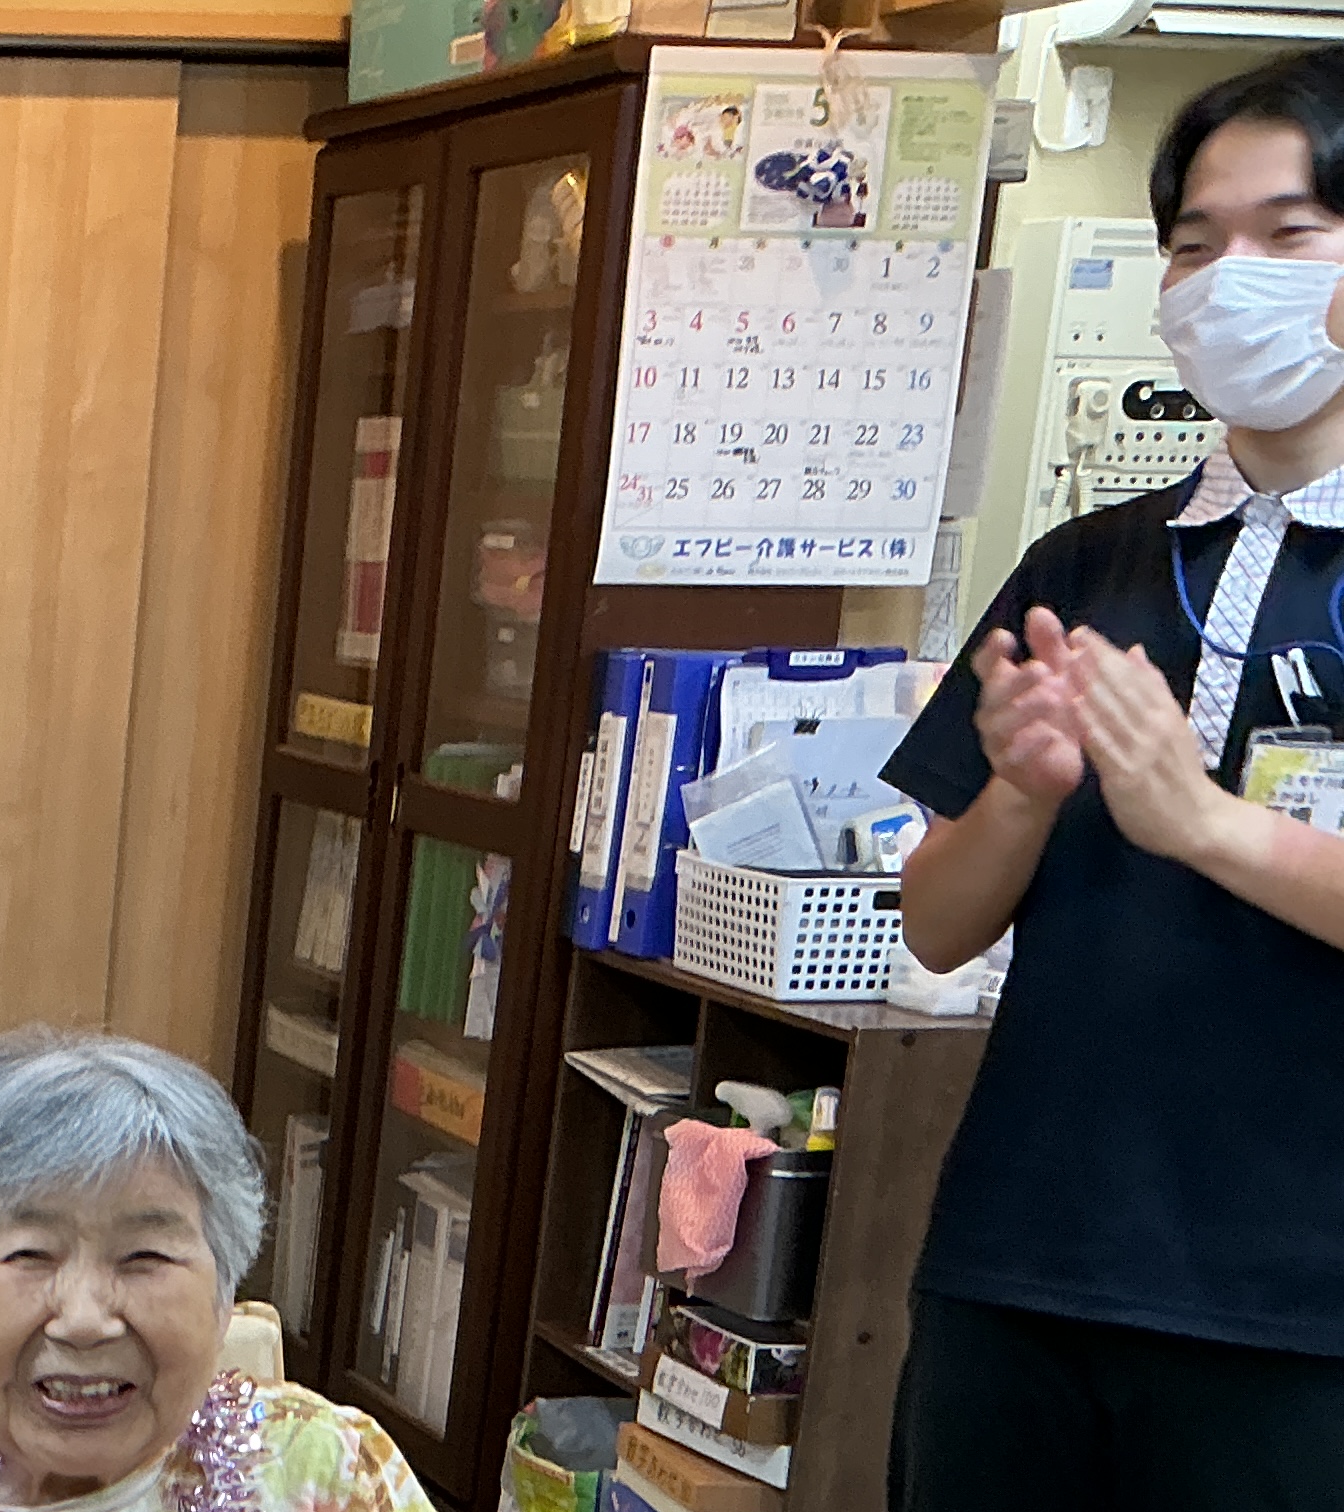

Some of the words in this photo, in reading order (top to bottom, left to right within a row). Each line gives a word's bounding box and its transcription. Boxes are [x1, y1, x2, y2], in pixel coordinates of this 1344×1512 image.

[810, 87, 830, 127] 5
[881, 257, 891, 278] 1
[925, 256, 941, 278] 2
[643, 310, 658, 332] 3
[689, 310, 703, 331] 4
[735, 311, 750, 333] 5
[782, 312, 796, 333] 6
[829, 312, 842, 333] 7
[872, 313, 888, 335] 8
[919, 313, 934, 333] 9
[634, 366, 657, 388] 10
[680, 367, 700, 388] 11
[726, 367, 750, 389] 12
[772, 367, 795, 390] 13
[818, 368, 841, 390] 14
[863, 368, 887, 390] 15
[907, 369, 931, 390] 16
[627, 422, 650, 443] 17
[674, 423, 696, 444] 18
[720, 423, 743, 444] 19
[764, 423, 788, 445] 20
[809, 423, 831, 445] 21
[854, 424, 879, 446] 22
[899, 424, 924, 447] 23
[665, 478, 689, 499] 25
[711, 478, 735, 500] 26
[756, 478, 781, 500] 27
[802, 478, 826, 500] 28
[846, 479, 871, 500] 29
[891, 479, 916, 500] 30
